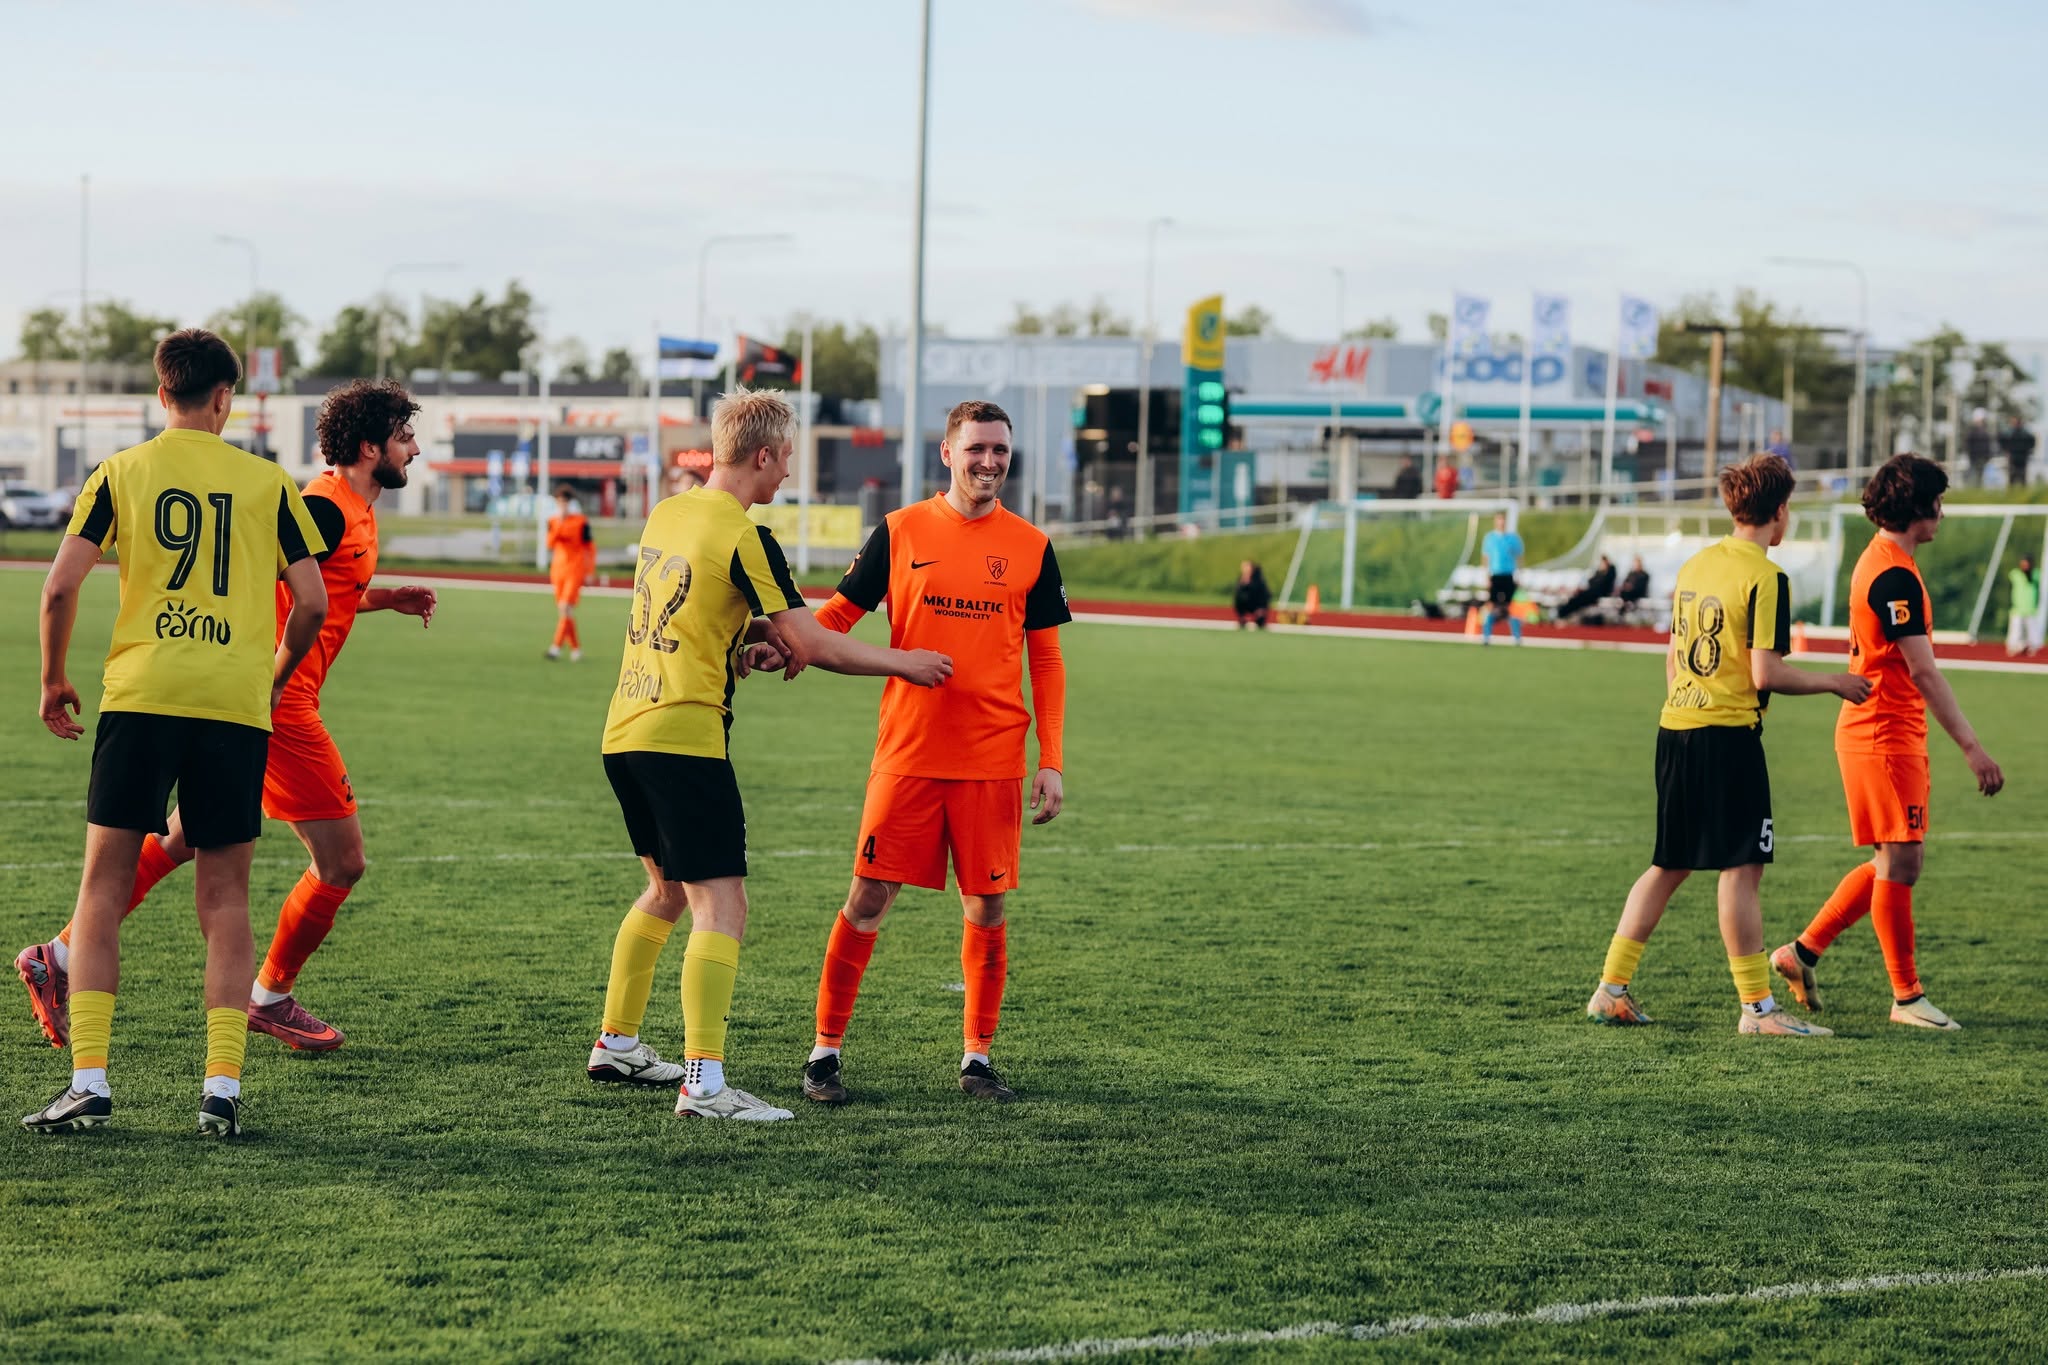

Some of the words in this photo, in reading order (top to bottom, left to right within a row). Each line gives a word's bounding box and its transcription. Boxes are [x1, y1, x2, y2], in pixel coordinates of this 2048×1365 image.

[154, 488, 232, 596] 91
[628, 546, 692, 654] 32
[923, 594, 952, 608] MKJ
[955, 598, 1004, 614] BALTIC
[934, 609, 972, 619] WOODEN
[1677, 591, 1724, 677] 58
[862, 835, 876, 864] 4
